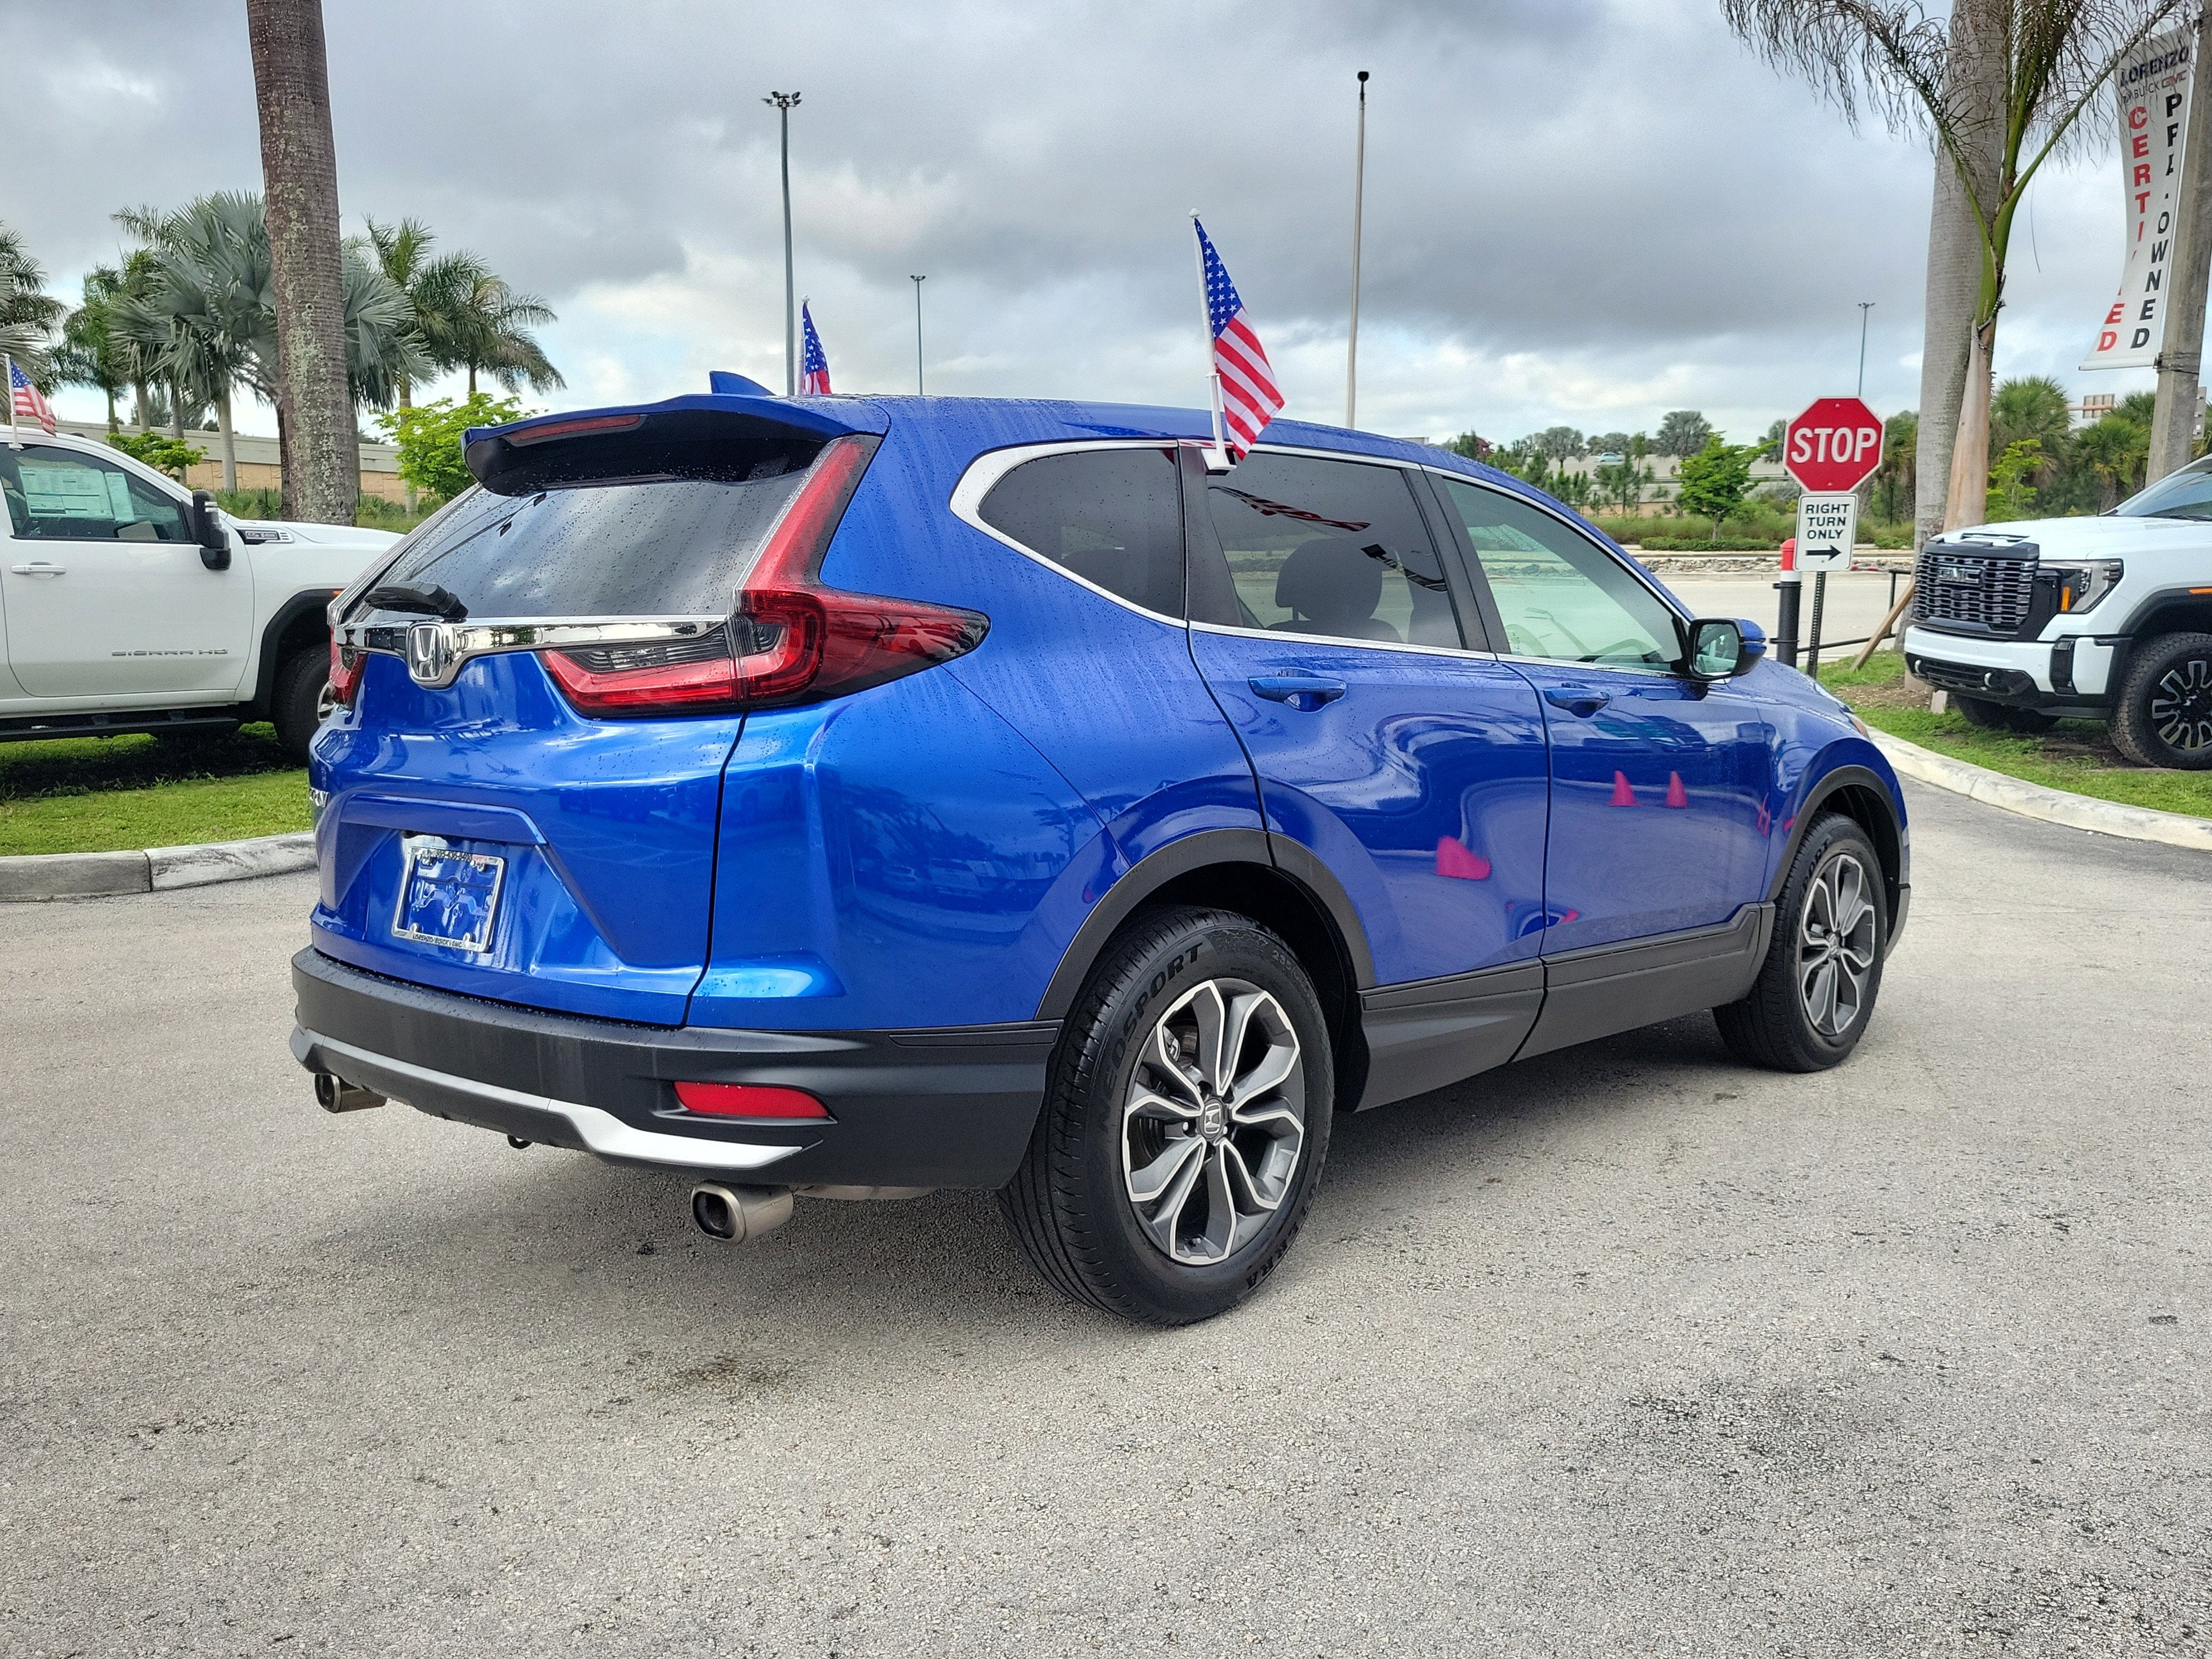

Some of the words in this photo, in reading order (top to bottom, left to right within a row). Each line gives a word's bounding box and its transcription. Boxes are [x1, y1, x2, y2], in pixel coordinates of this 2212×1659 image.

[2120, 46, 2189, 87] LORENZO
[2096, 106, 2151, 352] CERTIED
[1791, 427, 1878, 464] STOP
[1805, 503, 1850, 515] RIGHT
[1807, 516, 1847, 527] TURN
[1807, 529, 1844, 540] ONLY
[1938, 567, 1980, 584] GMC
